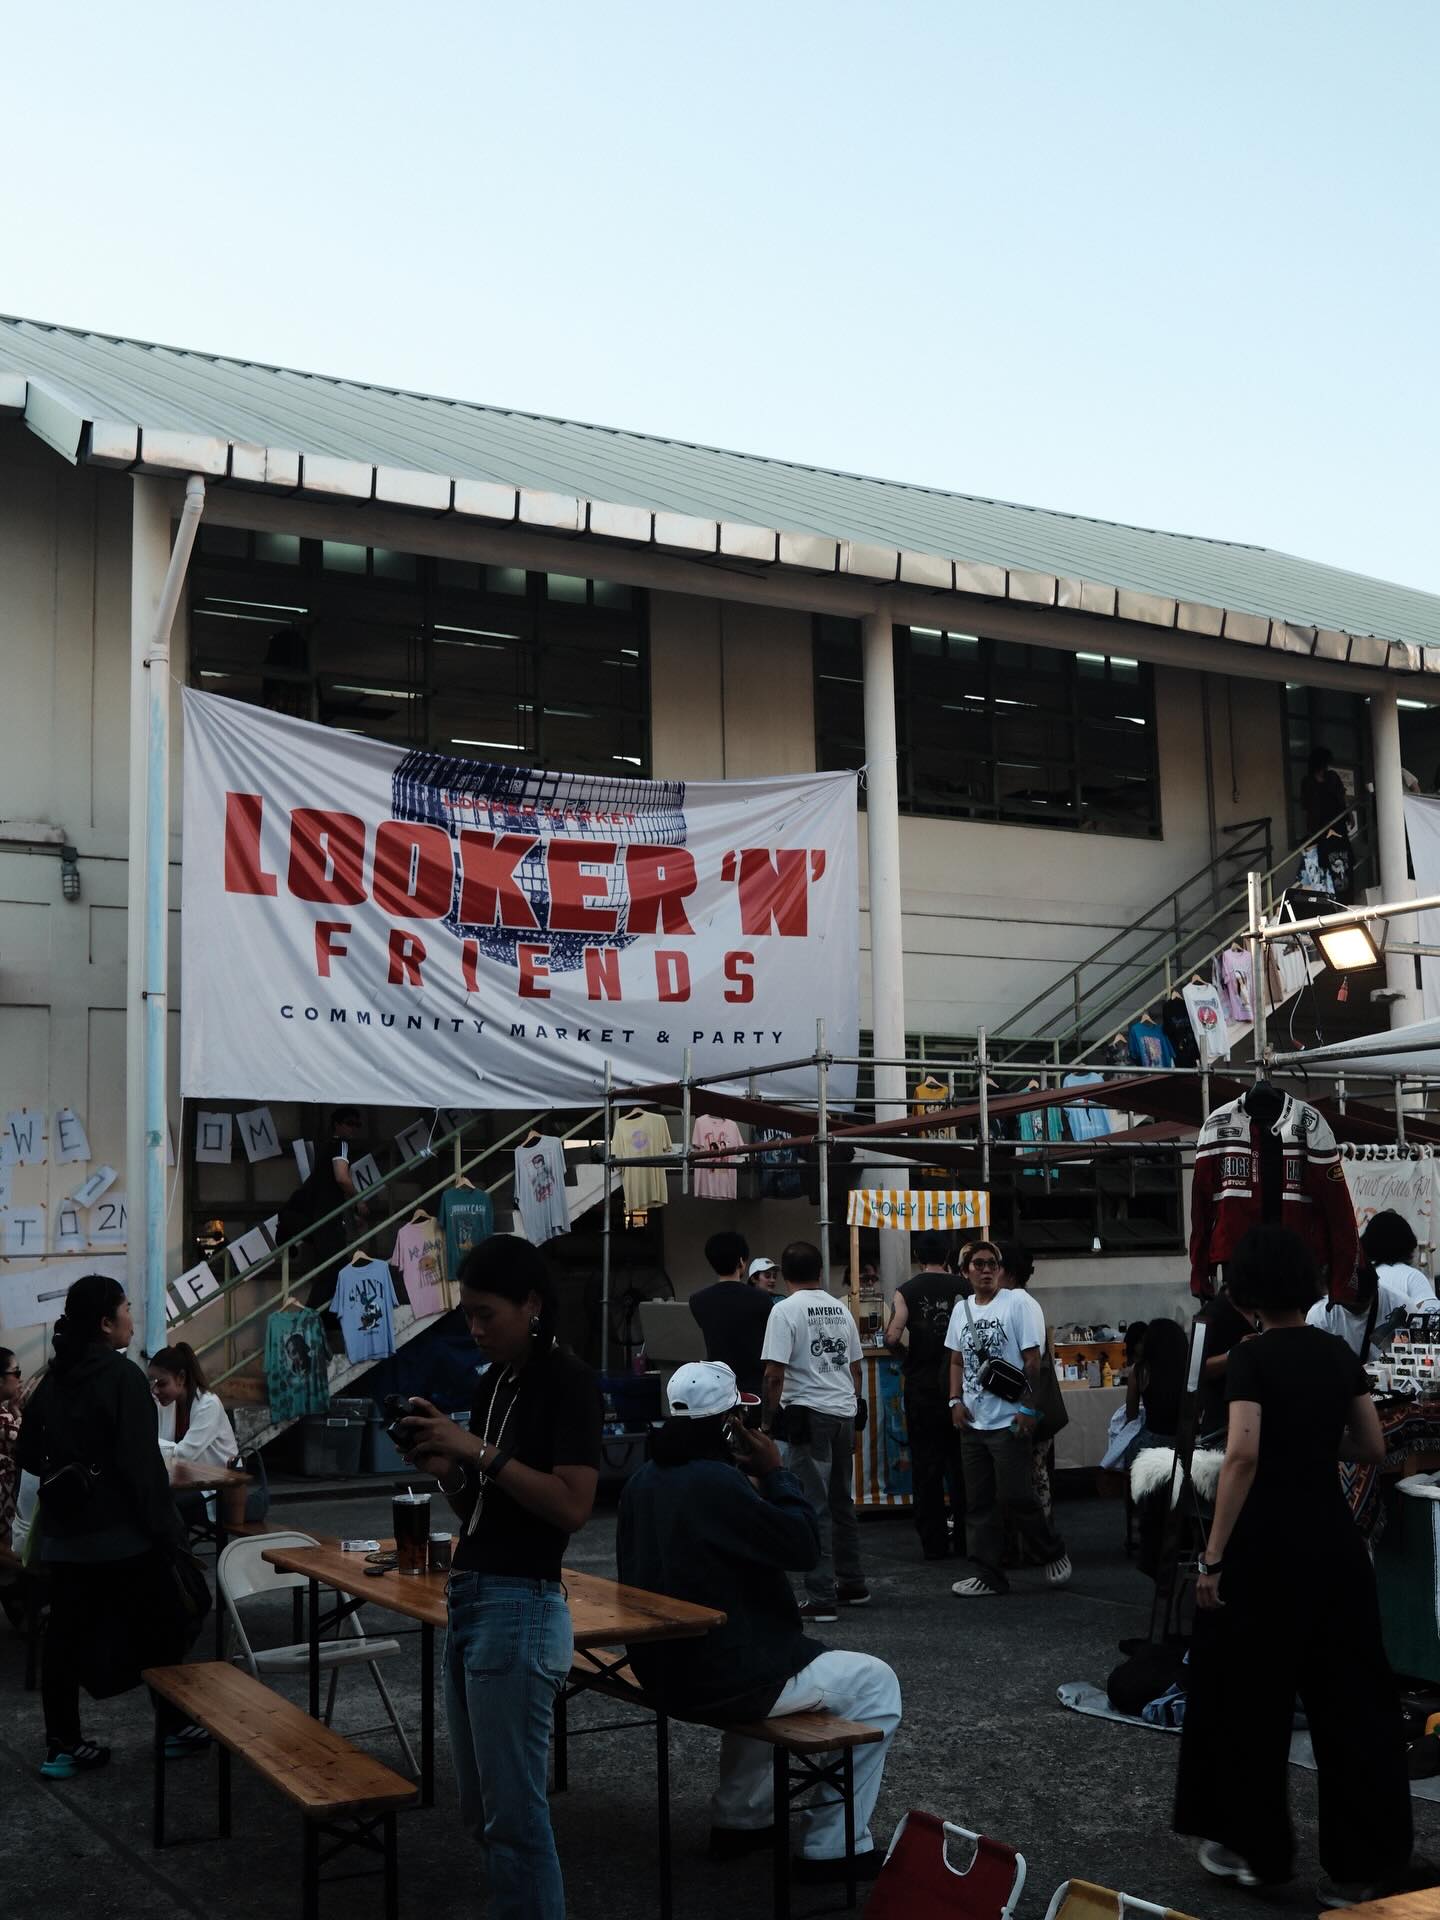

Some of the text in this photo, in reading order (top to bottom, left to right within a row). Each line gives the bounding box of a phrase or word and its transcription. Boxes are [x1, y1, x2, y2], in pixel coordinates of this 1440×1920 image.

[443, 795, 635, 826] LOOKER MARKET
[225, 791, 697, 936] LOOKER
[314, 920, 755, 1004] FRIENDS
[280, 1004, 785, 1045] COMMUNITY MARKET & PARTY
[871, 1201, 976, 1217] HONEY LEMON
